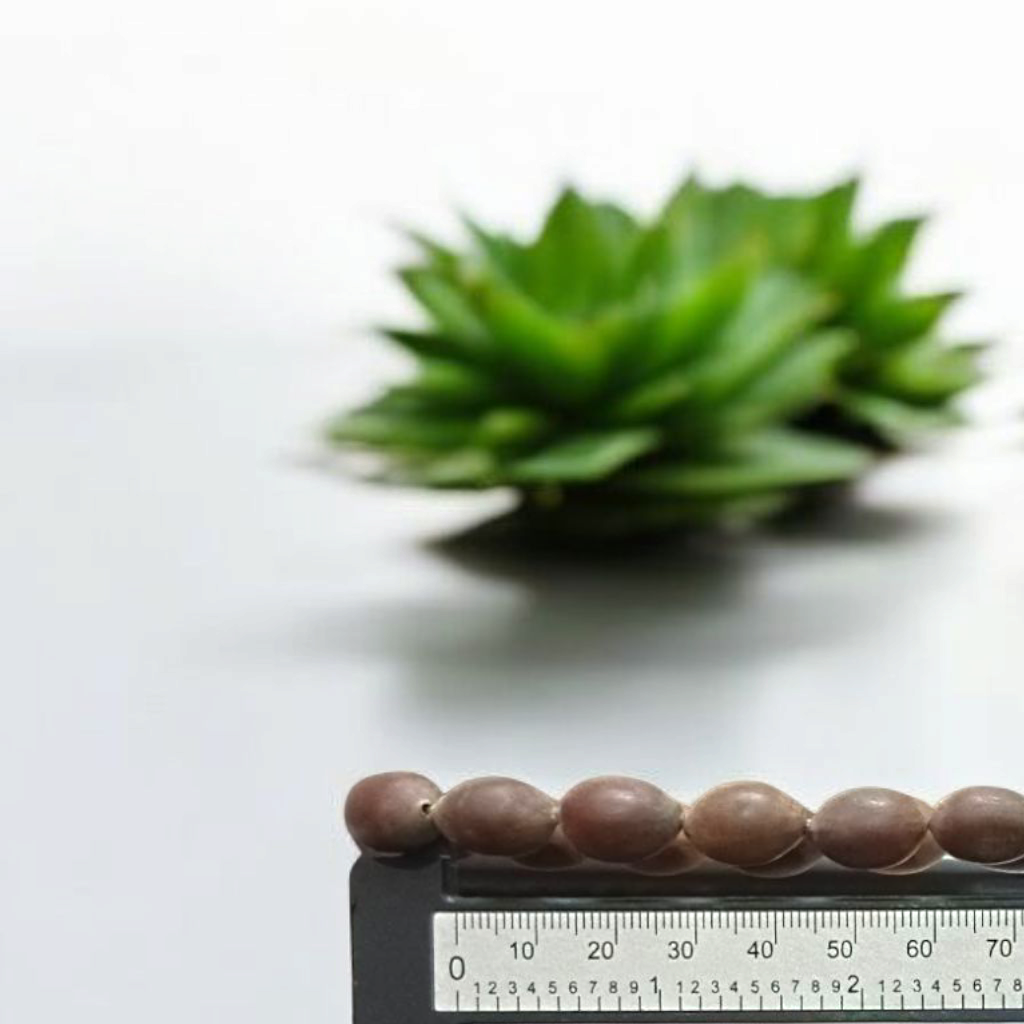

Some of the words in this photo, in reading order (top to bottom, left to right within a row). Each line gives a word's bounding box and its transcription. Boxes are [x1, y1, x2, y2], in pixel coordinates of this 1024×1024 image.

[509, 940, 535, 961] 10
[587, 940, 615, 961] 20
[667, 940, 695, 960] 30
[746, 939, 774, 960] 40
[826, 939, 853, 959] 50
[906, 939, 933, 959] 60
[985, 938, 1013, 959] 70
[448, 955, 466, 981] 0
[487, 980, 498, 996] 2
[508, 980, 518, 996] 3
[526, 981, 537, 995] 4
[547, 980, 558, 995] 5
[568, 980, 579, 995] 6
[588, 979, 598, 995] 7
[608, 980, 619, 995] 8
[628, 979, 640, 995] 9
[690, 979, 701, 995] 2
[711, 979, 721, 995] 3
[728, 980, 739, 994] 4
[750, 979, 760, 995] 5
[770, 979, 781, 995] 6
[791, 978, 801, 994] 7
[810, 979, 821, 994] 8
[831, 979, 841, 994] 9
[846, 973, 860, 994] 2
[892, 978, 903, 994] 2
[912, 978, 923, 993] 3
[930, 979, 941, 993] 4
[952, 978, 963, 993] 5
[972, 978, 983, 993] 6
[992, 977, 1003, 993] 7
[1012, 977, 1023, 993] 8
